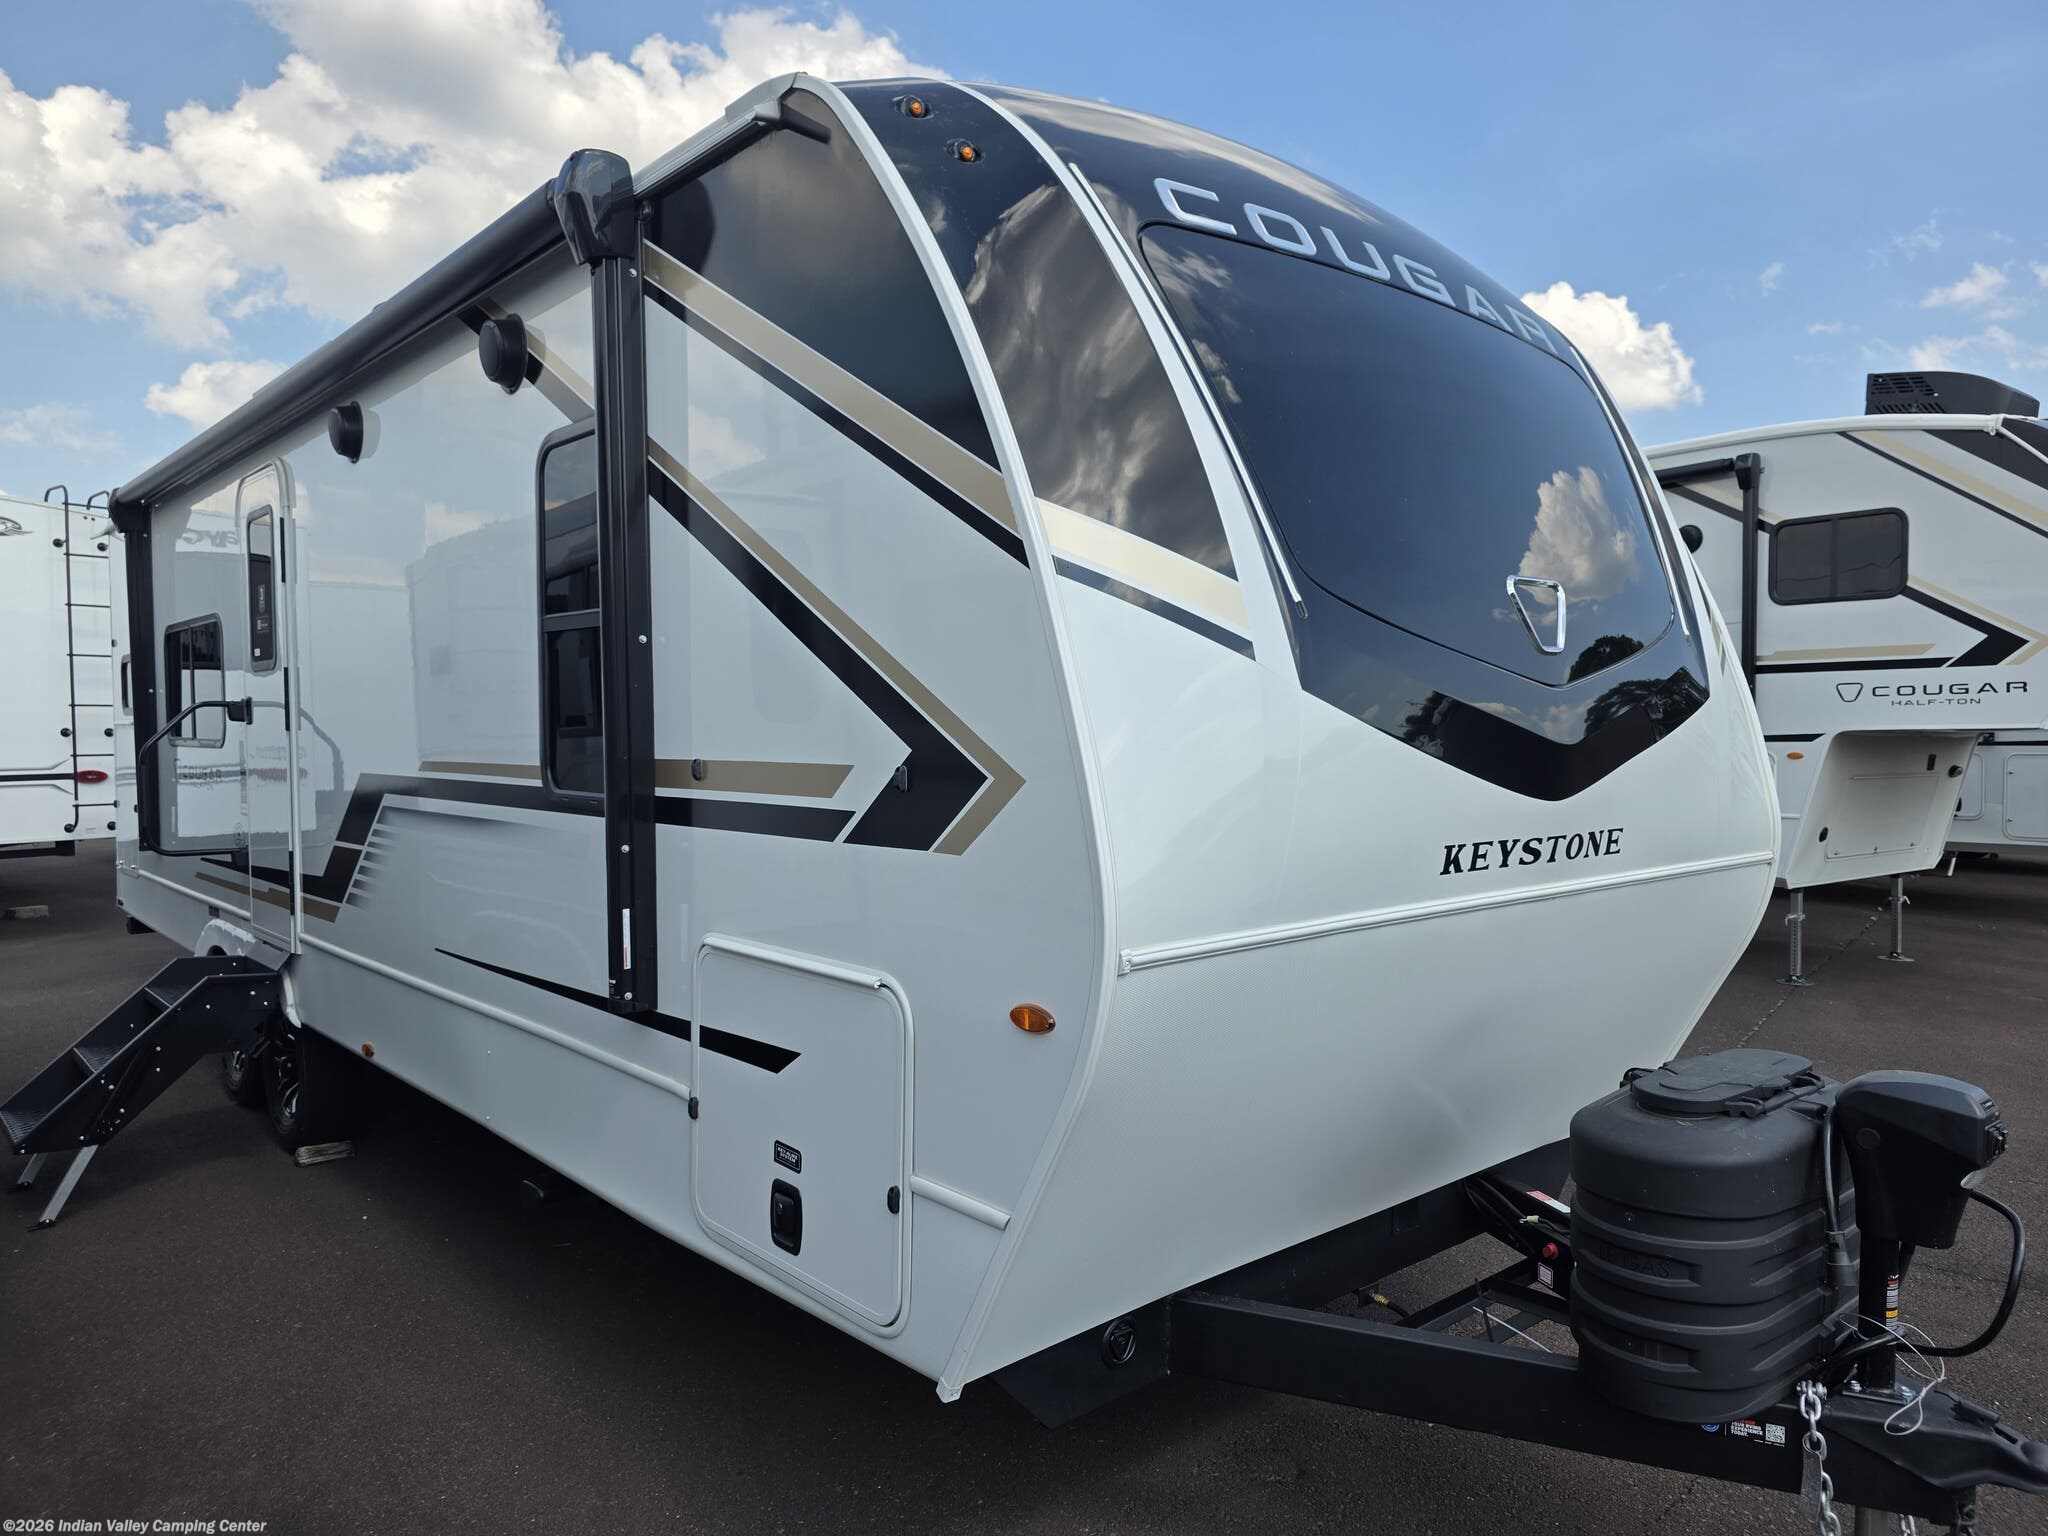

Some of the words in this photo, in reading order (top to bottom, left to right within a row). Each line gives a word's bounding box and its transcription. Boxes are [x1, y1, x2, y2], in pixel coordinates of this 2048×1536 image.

[1153, 177, 1560, 356] COUGAR
[1872, 681, 2028, 697] COUGAR
[1891, 698, 1981, 706] HALF-TON
[1440, 828, 1624, 875] KEYSTONE
